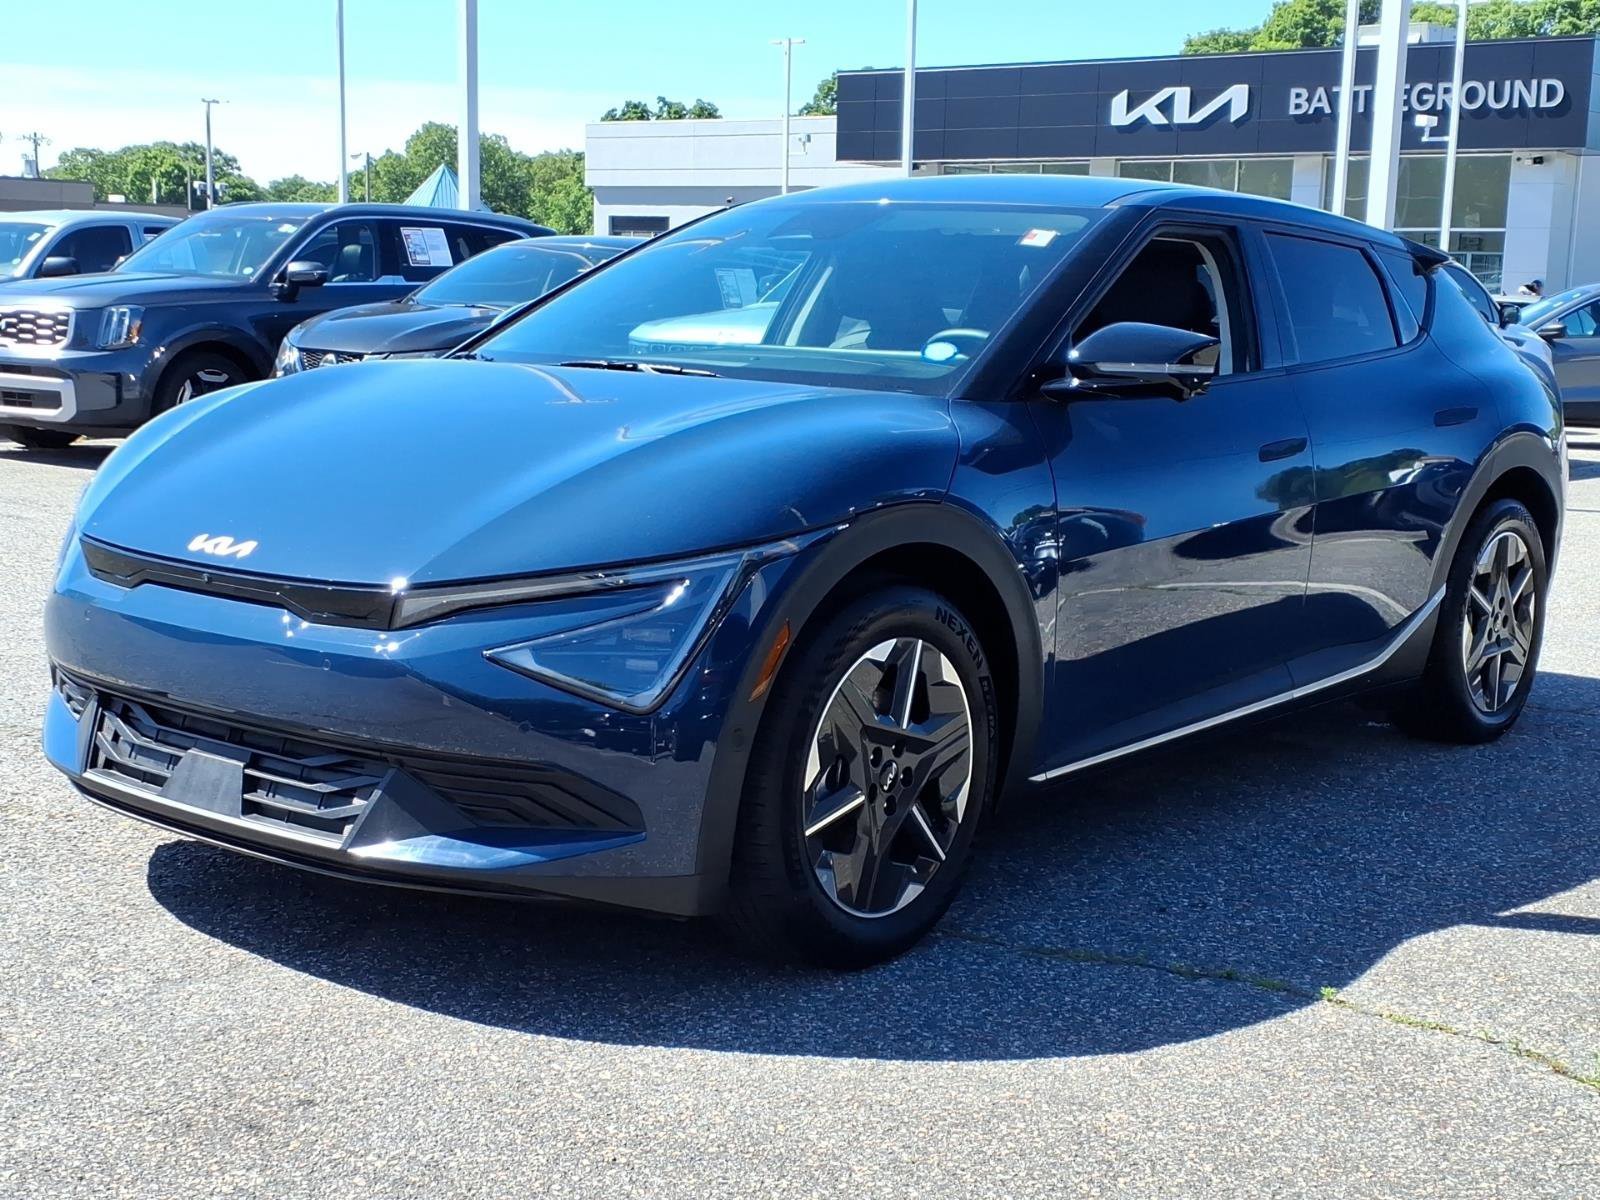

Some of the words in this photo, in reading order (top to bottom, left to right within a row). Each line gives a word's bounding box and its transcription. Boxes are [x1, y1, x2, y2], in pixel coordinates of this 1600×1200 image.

[1111, 84, 1249, 125] KIA
[1289, 78, 1564, 115] BATEGROUND
[187, 533, 258, 558] KIA
[935, 606, 984, 670] NEXEN
